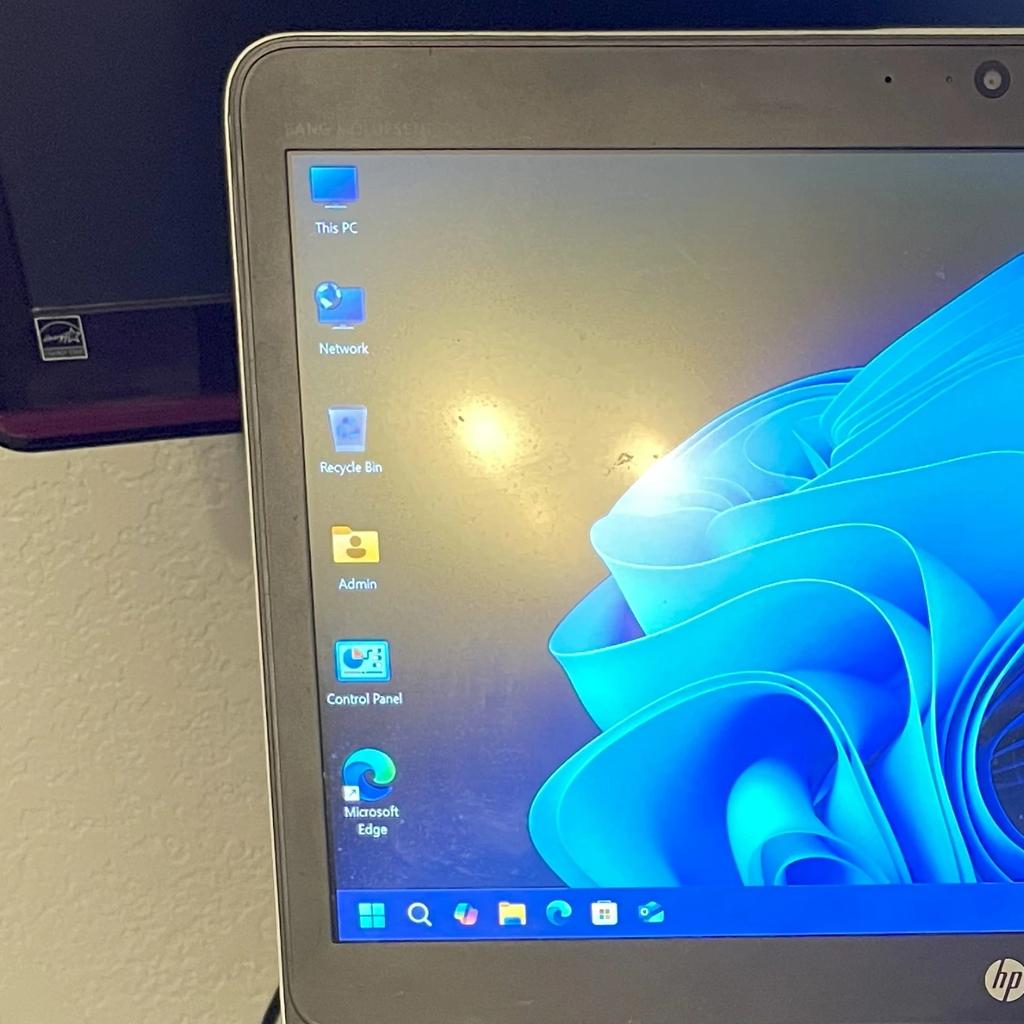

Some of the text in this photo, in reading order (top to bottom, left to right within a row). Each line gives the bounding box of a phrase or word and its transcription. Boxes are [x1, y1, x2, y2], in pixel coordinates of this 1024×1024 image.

[315, 222, 357, 233] This PC
[320, 342, 369, 354] Network
[320, 461, 382, 476] Recycle Bin
[339, 578, 377, 589] Admin
[327, 692, 402, 705] Control Panel
[344, 803, 399, 817] Microsoft
[358, 823, 388, 837] Edge
